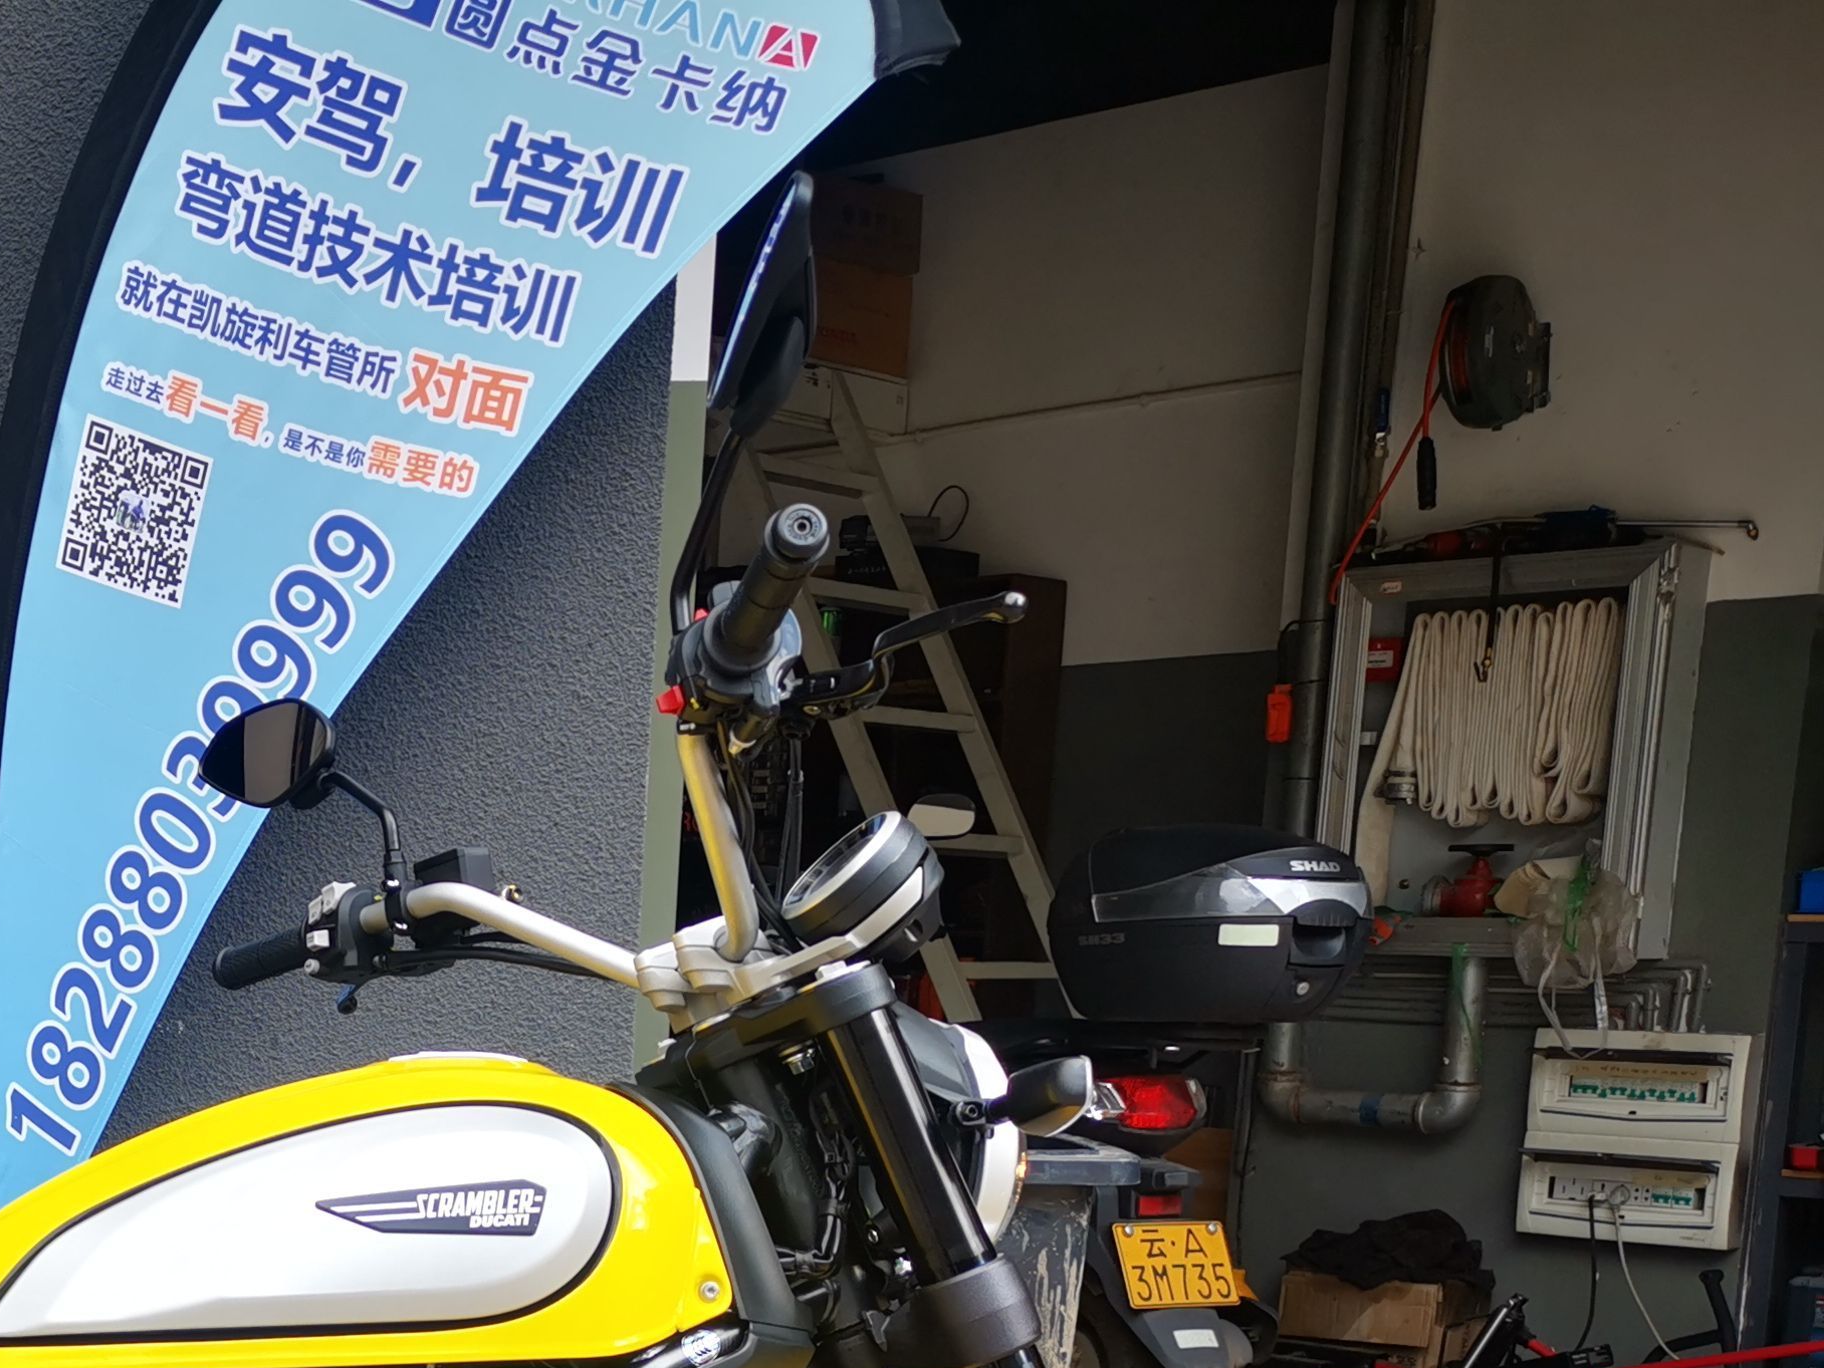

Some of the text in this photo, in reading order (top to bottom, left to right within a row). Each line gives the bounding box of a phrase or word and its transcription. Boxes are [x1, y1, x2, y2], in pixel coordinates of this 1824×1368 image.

[445, 0, 788, 133] 圆点金卡纳
[180, 157, 578, 342] 弯道技术培训
[475, 122, 684, 253] 培训
[121, 266, 529, 430] 就在凯旋利车管所 对面
[1290, 859, 1342, 872] SHAD
[469, 1213, 530, 1228] DUCATI
[1131, 1263, 1231, 1302] 3M735
